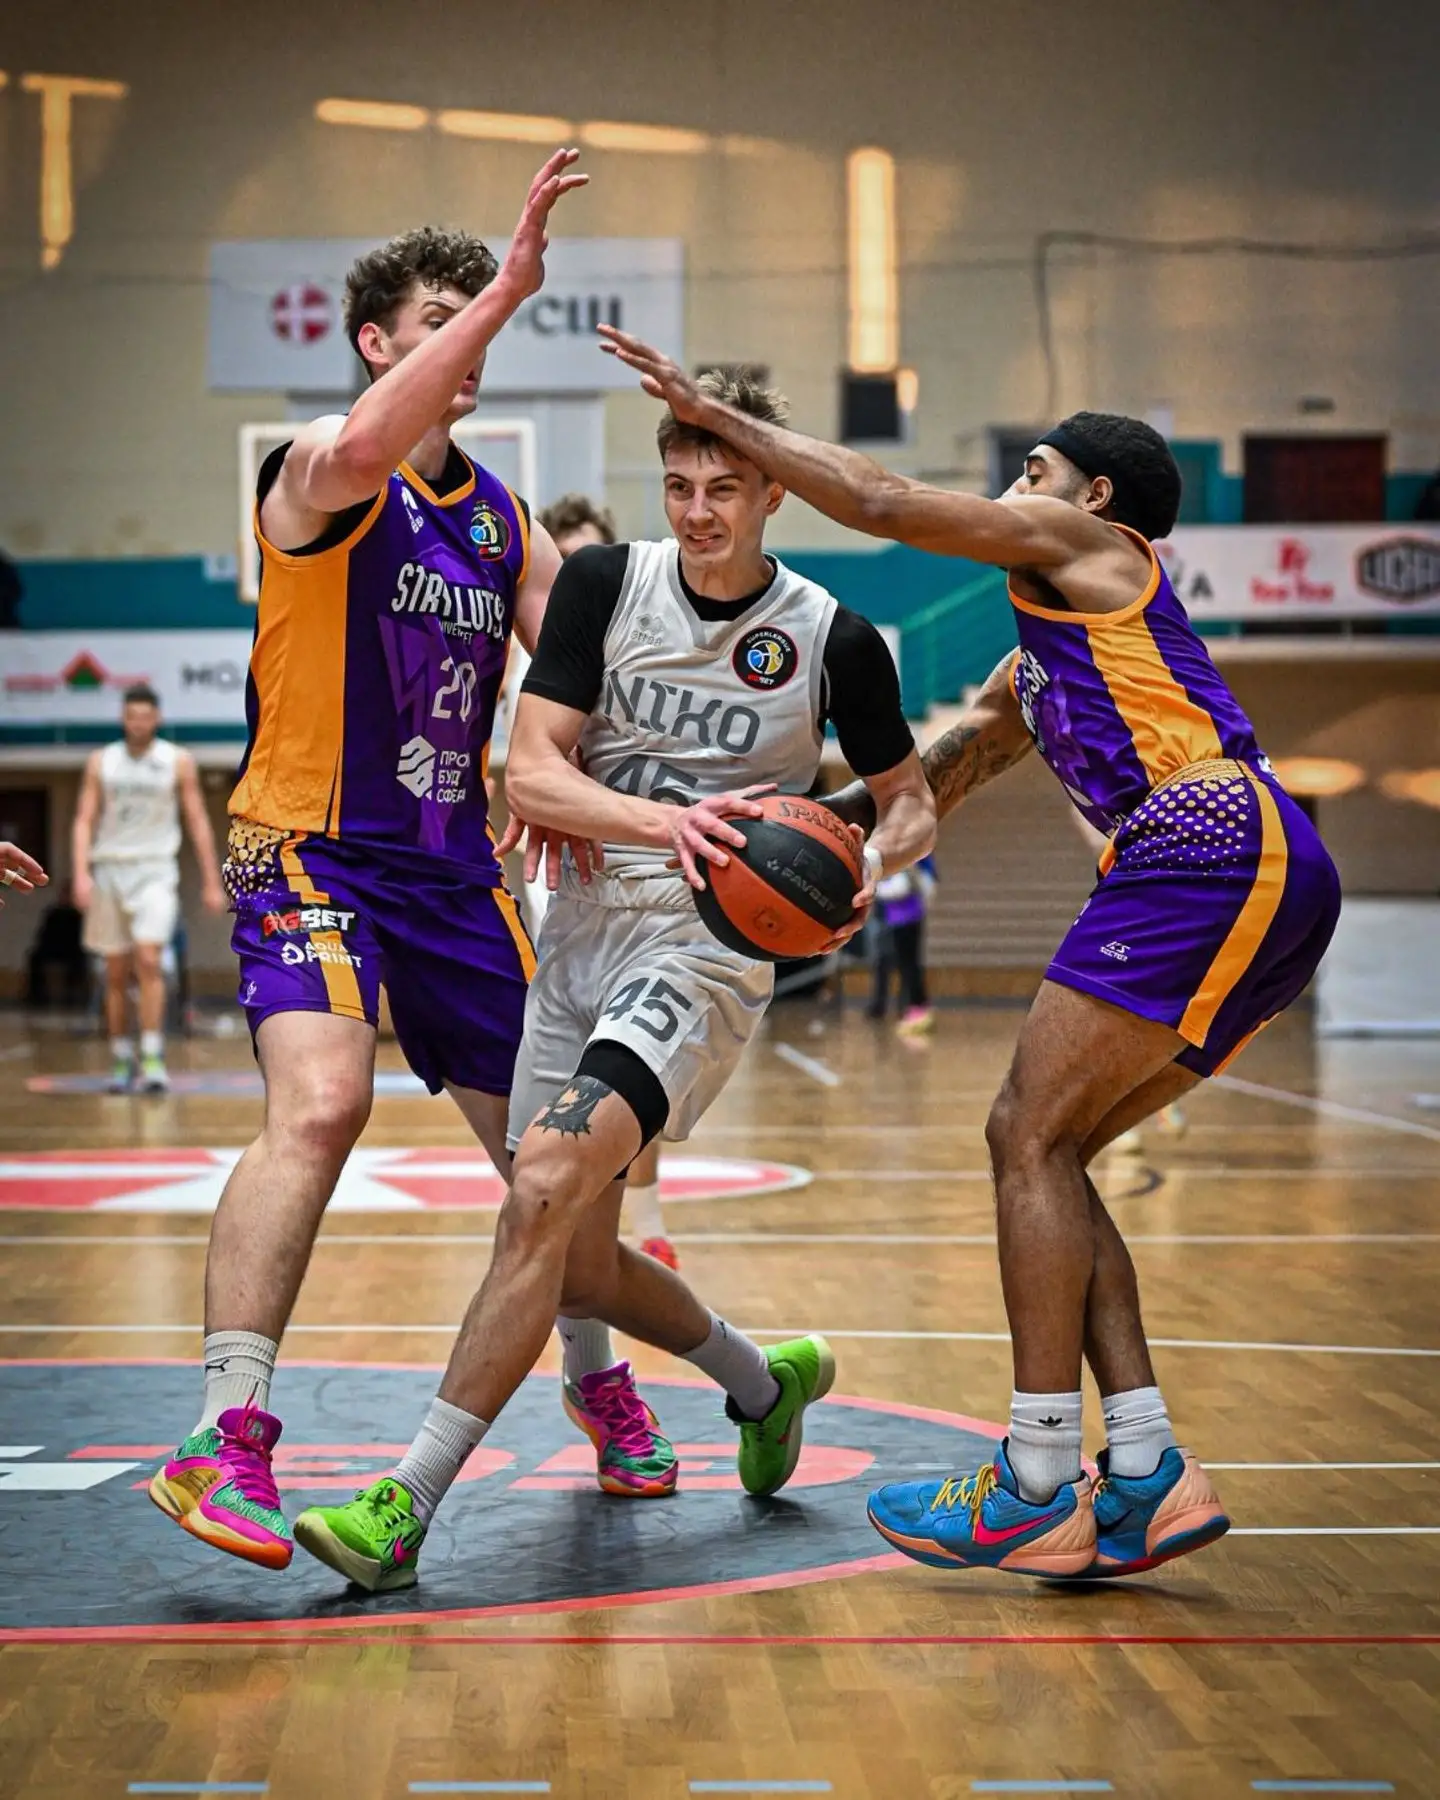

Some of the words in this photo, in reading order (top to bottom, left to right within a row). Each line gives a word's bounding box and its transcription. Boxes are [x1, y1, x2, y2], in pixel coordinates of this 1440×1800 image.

[432, 656, 477, 722] 20
[604, 670, 761, 755] NIKO
[440, 751, 470, 767] ПРО
[307, 952, 362, 968] PRINT
[604, 977, 693, 1042] 45
